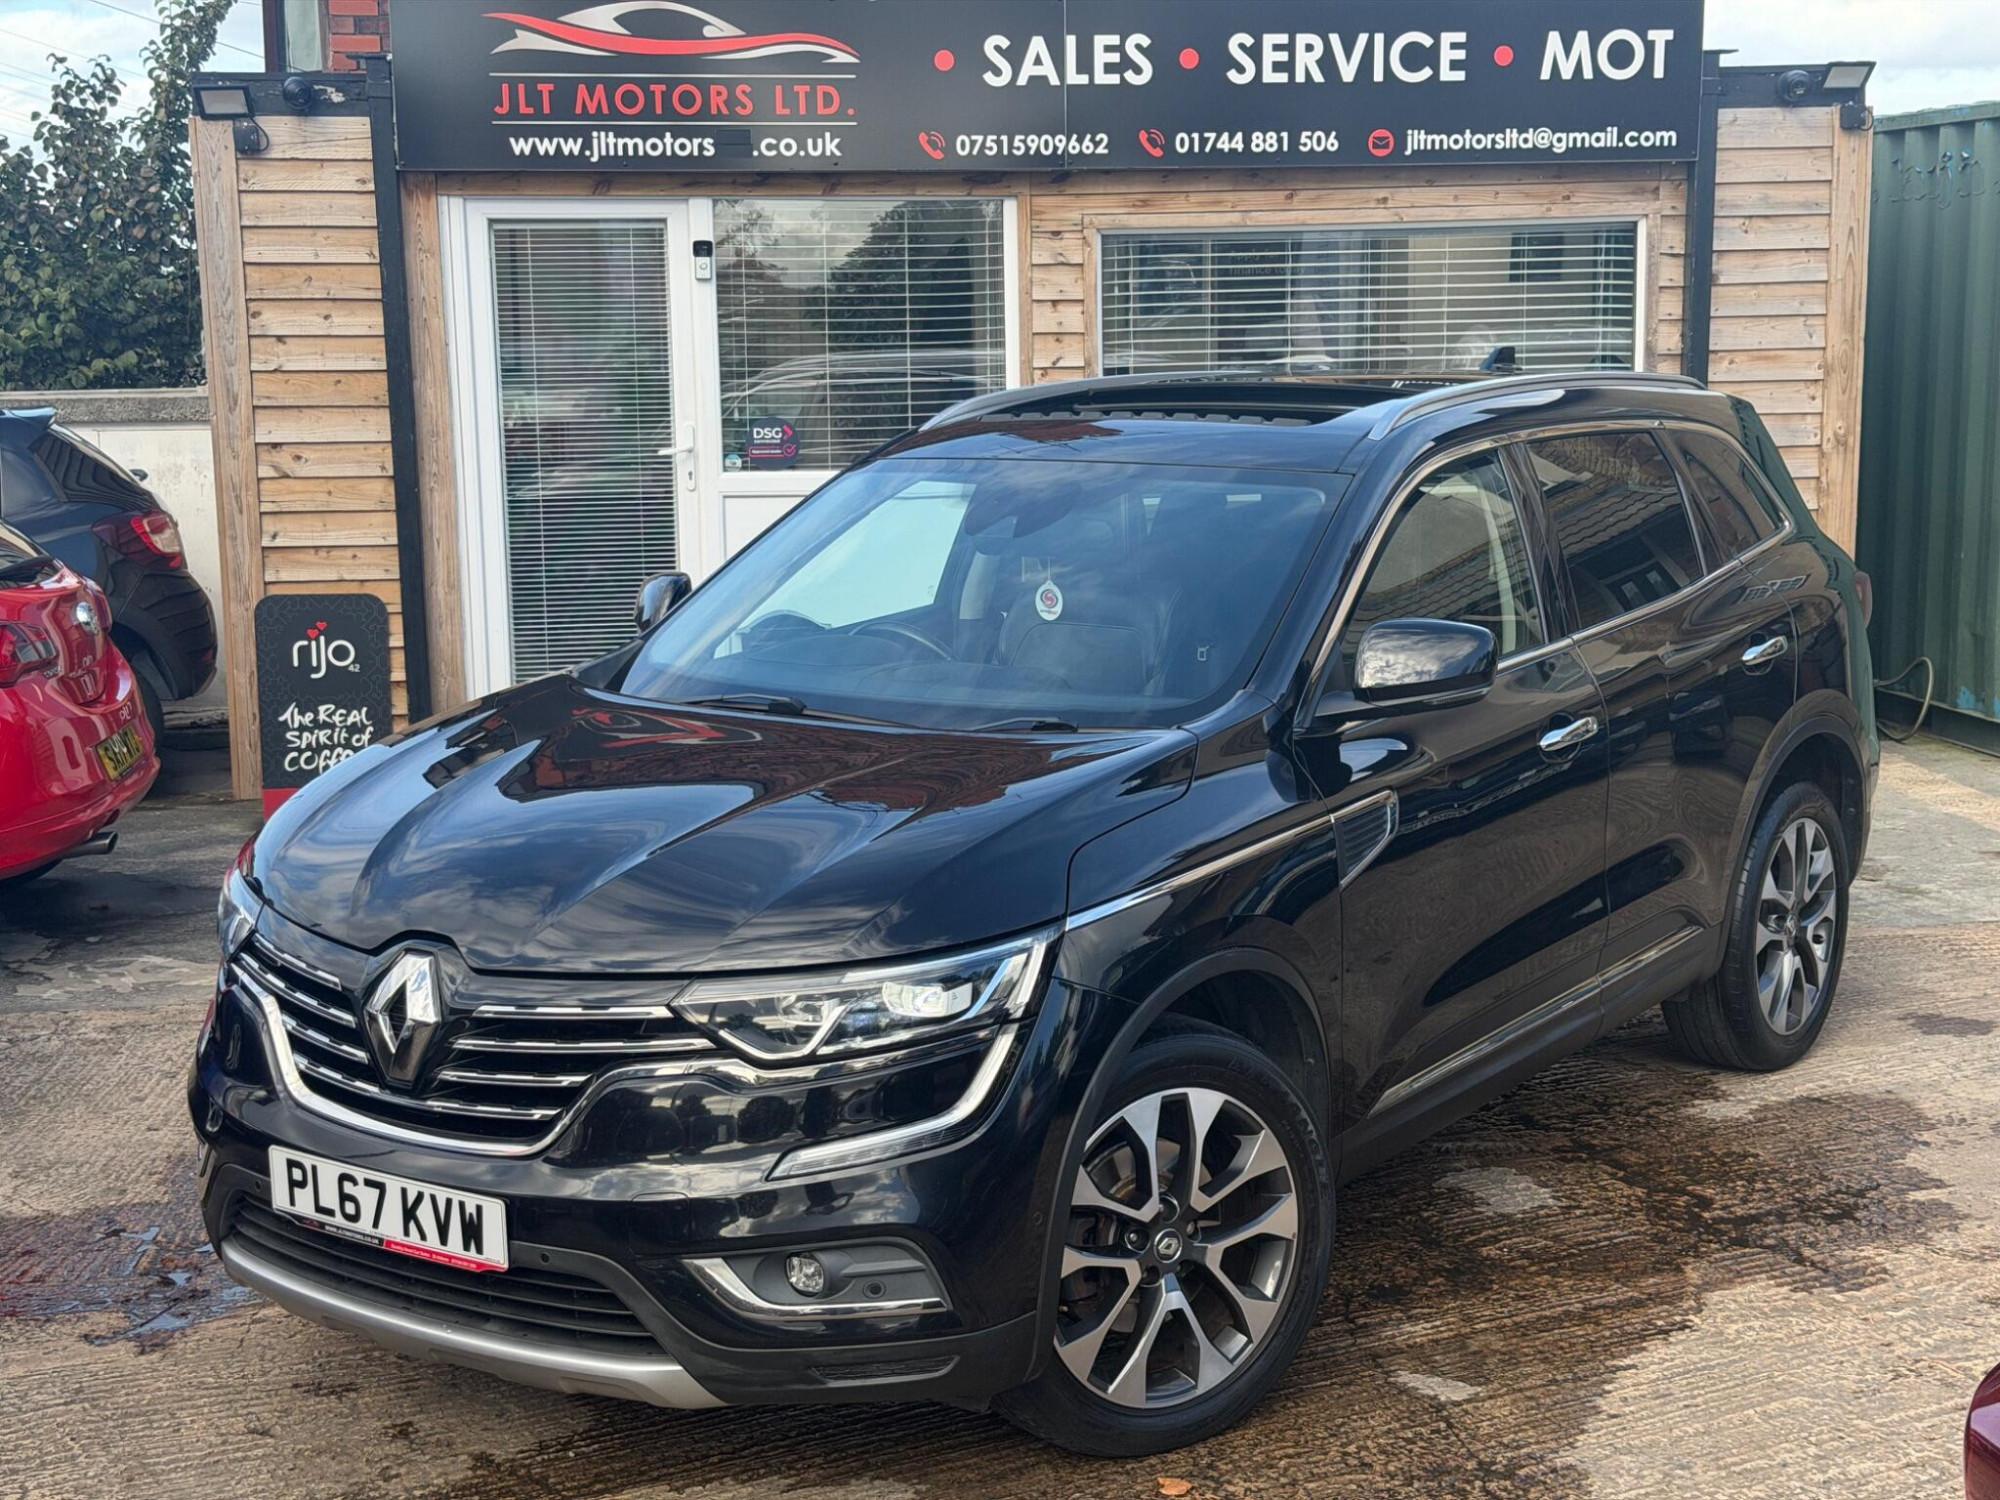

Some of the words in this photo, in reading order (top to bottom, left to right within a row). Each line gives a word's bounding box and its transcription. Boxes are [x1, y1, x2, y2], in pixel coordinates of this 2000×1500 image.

[982, 33, 1153, 87] SALES
[1226, 31, 1467, 84] SERVICE
[1539, 29, 1674, 80] MOT
[495, 83, 555, 116] JLT
[575, 82, 753, 117] MOTORS
[775, 84, 855, 116] LTD.
[955, 133, 1110, 157] 07515909662
[1174, 132, 1245, 154] 01744
[1250, 132, 1290, 153] 881
[1298, 131, 1339, 153] 506
[1404, 127, 1678, 156] jltmotorsltd@gmail.com
[753, 427, 783, 439] DSG
[351, 726, 375, 748] of
[286, 1157, 387, 1230] PL67
[400, 1186, 484, 1256] KVW
